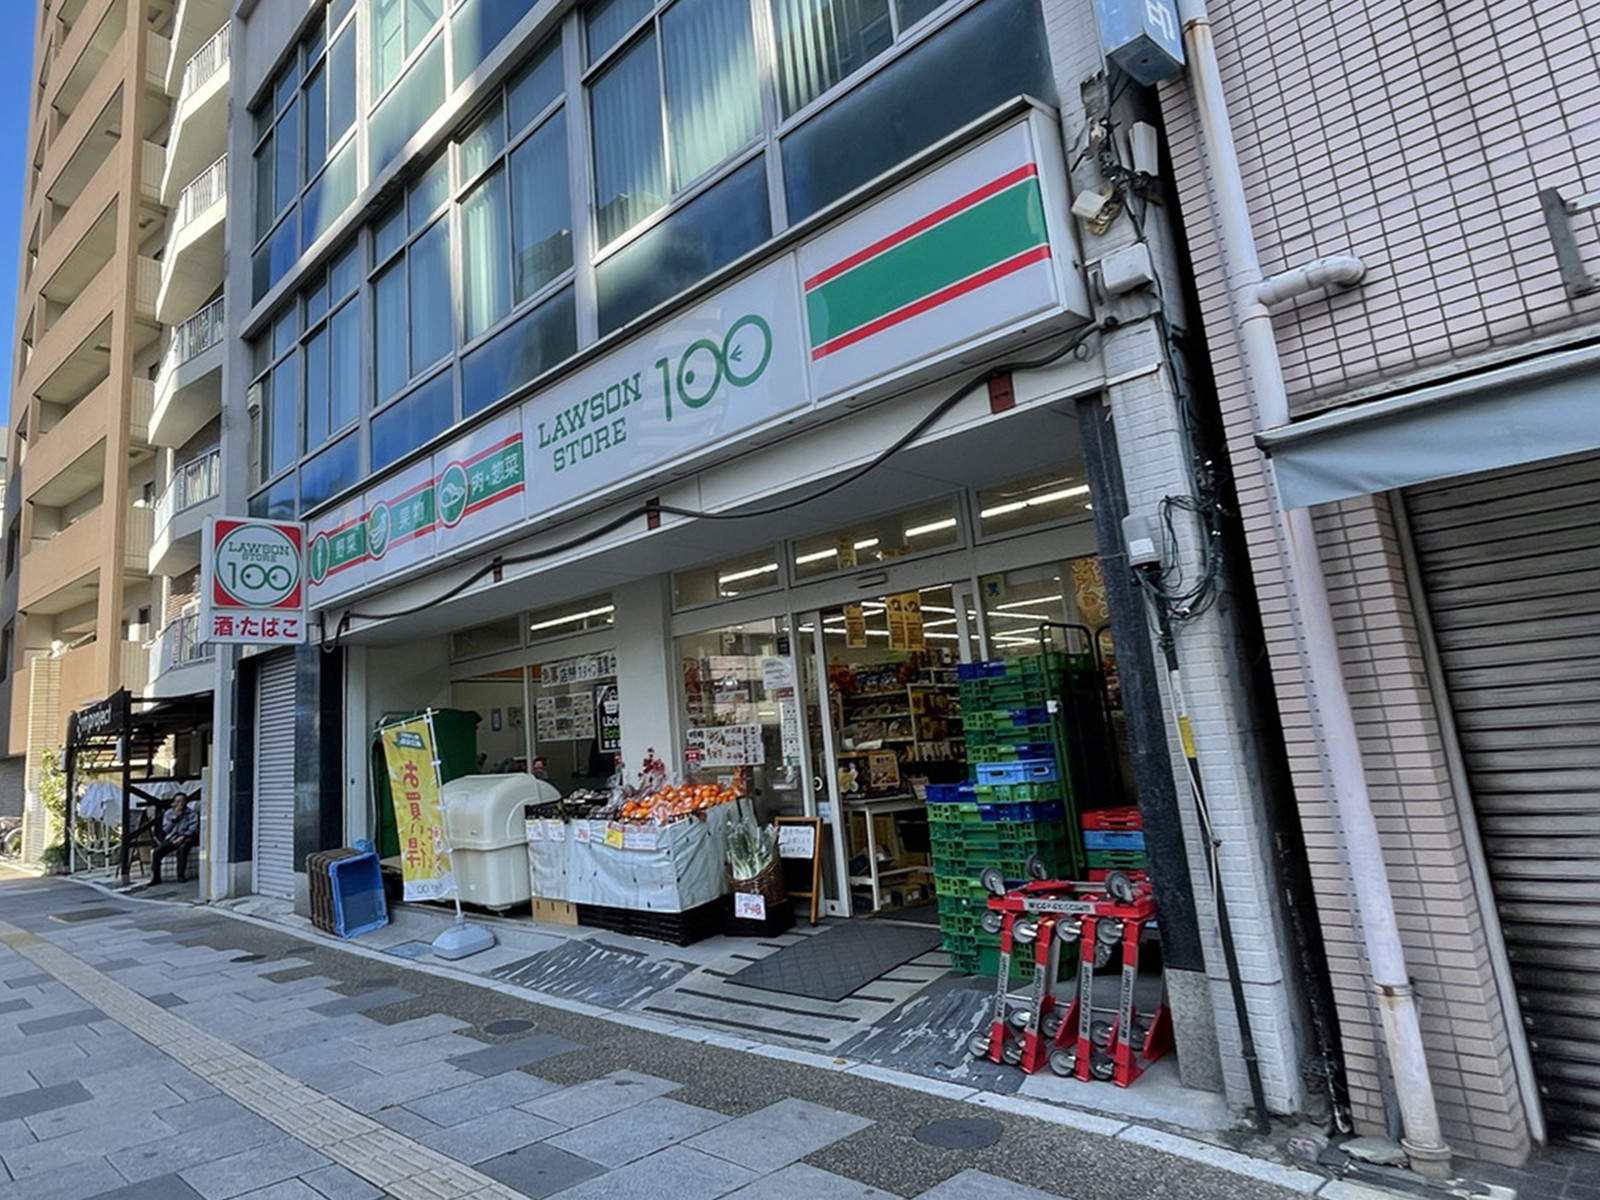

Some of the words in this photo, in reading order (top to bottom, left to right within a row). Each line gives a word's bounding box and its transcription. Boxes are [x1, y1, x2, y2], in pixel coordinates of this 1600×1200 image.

[654, 313, 772, 422] 100
[538, 372, 642, 449] LAWSON
[554, 417, 627, 472] STORE
[228, 541, 289, 556] LAWSON
[242, 553, 277, 562] STORE
[228, 562, 292, 592] 100
[213, 616, 299, 638] 酒・たばこ
